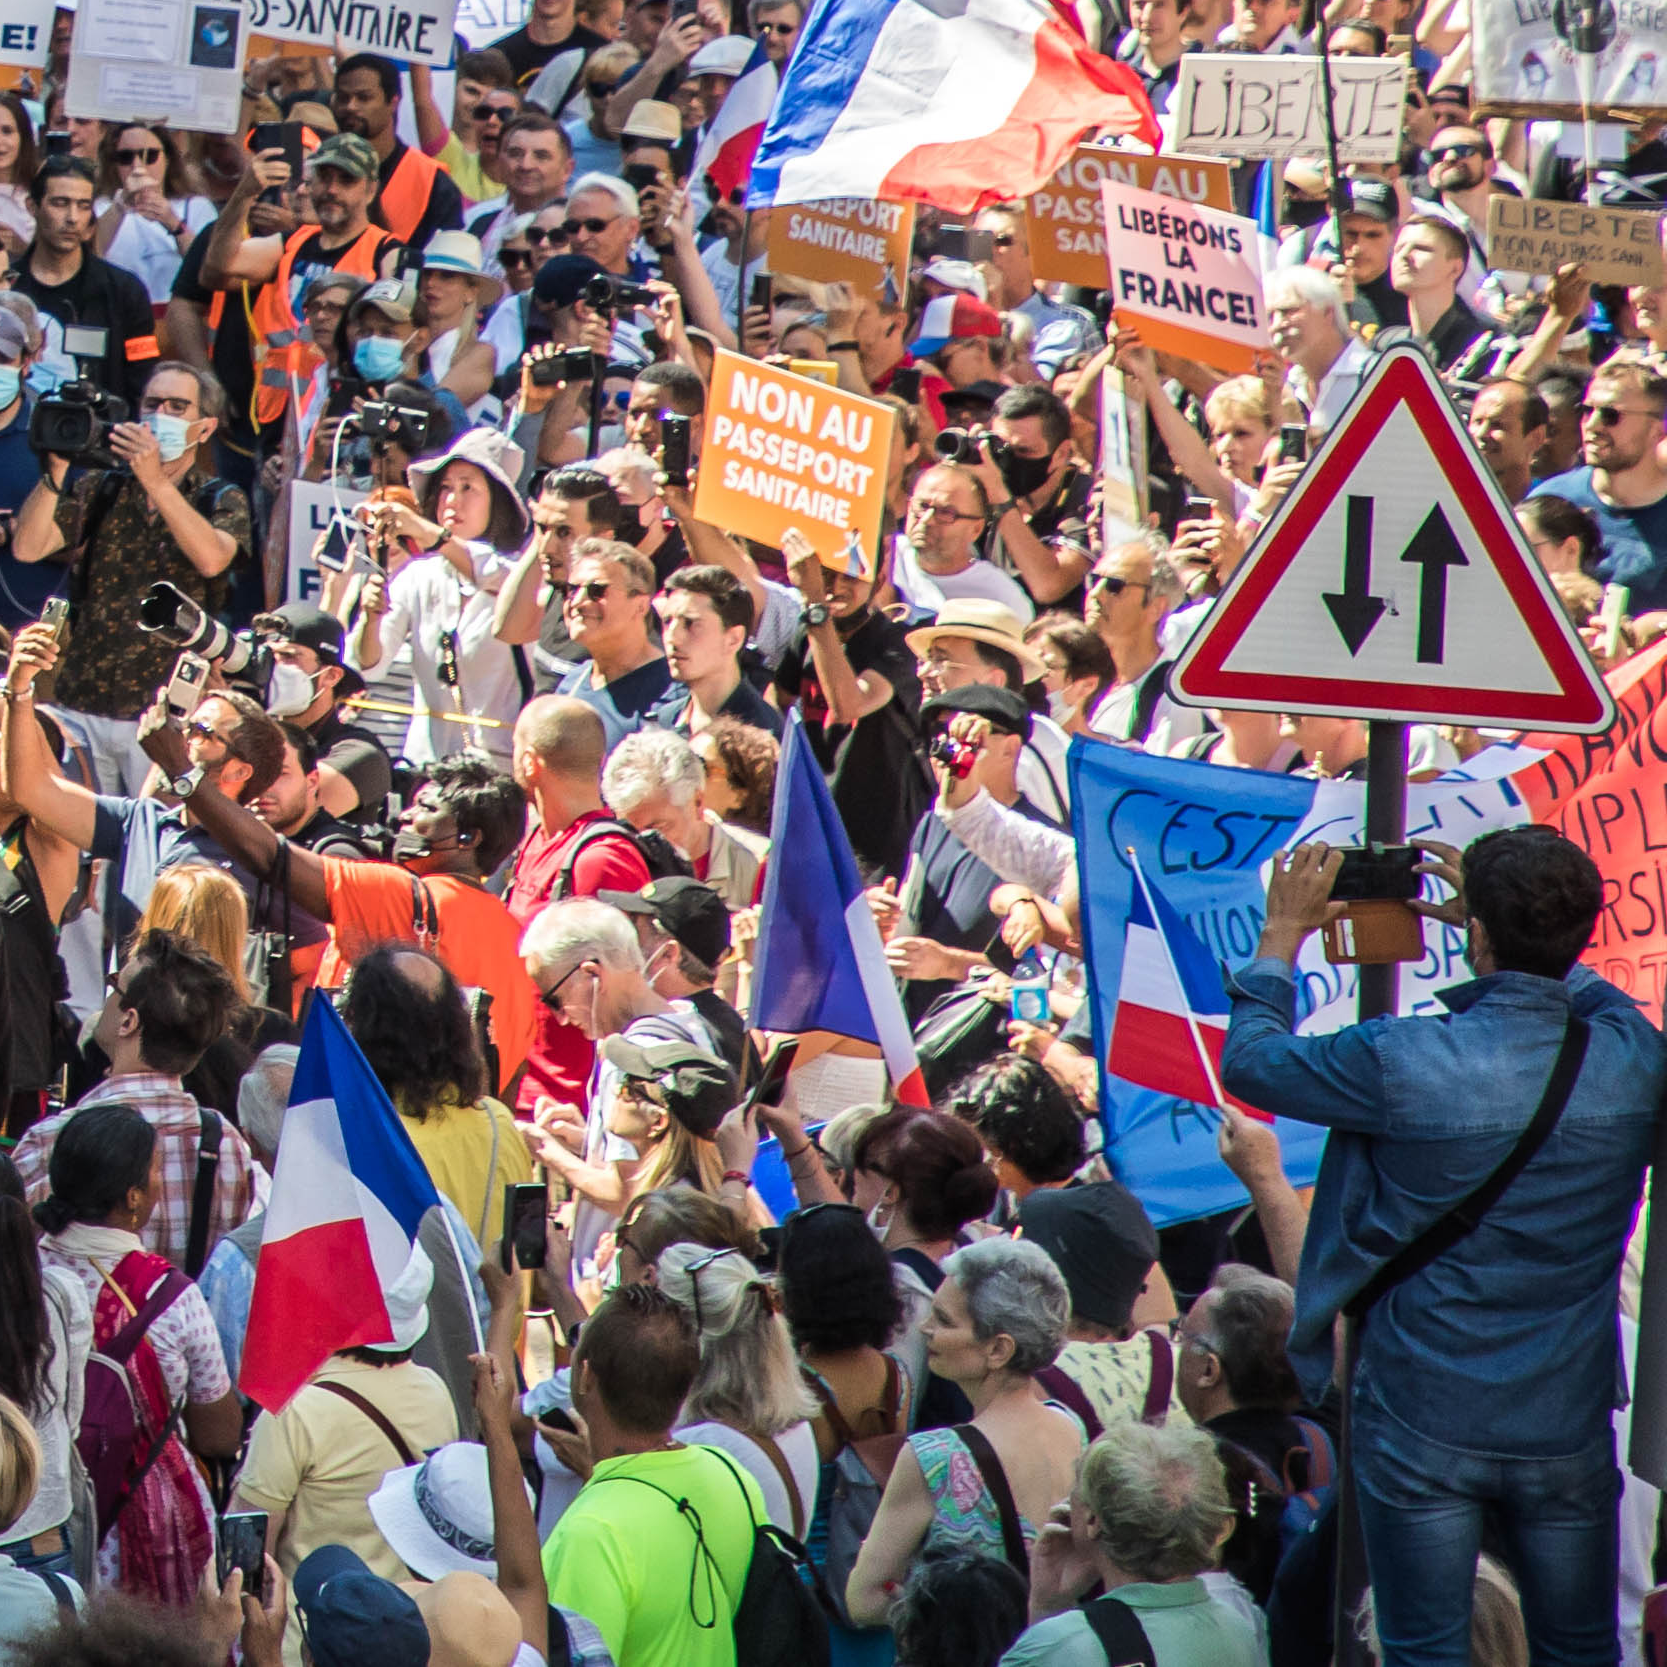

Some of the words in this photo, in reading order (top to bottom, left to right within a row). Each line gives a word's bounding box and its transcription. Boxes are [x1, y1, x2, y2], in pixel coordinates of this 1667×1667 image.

[1151, 165, 1209, 203] AU
[787, 214, 887, 265] SANITAIRE
[1117, 203, 1244, 255] LIBÉRONS
[1162, 239, 1197, 273] LA
[1117, 267, 1259, 329] FRANCE!
[729, 370, 815, 435] NON
[817, 404, 874, 454] AU
[711, 414, 874, 497] PASSEPORT
[722, 459, 851, 529] SANITAIRE
